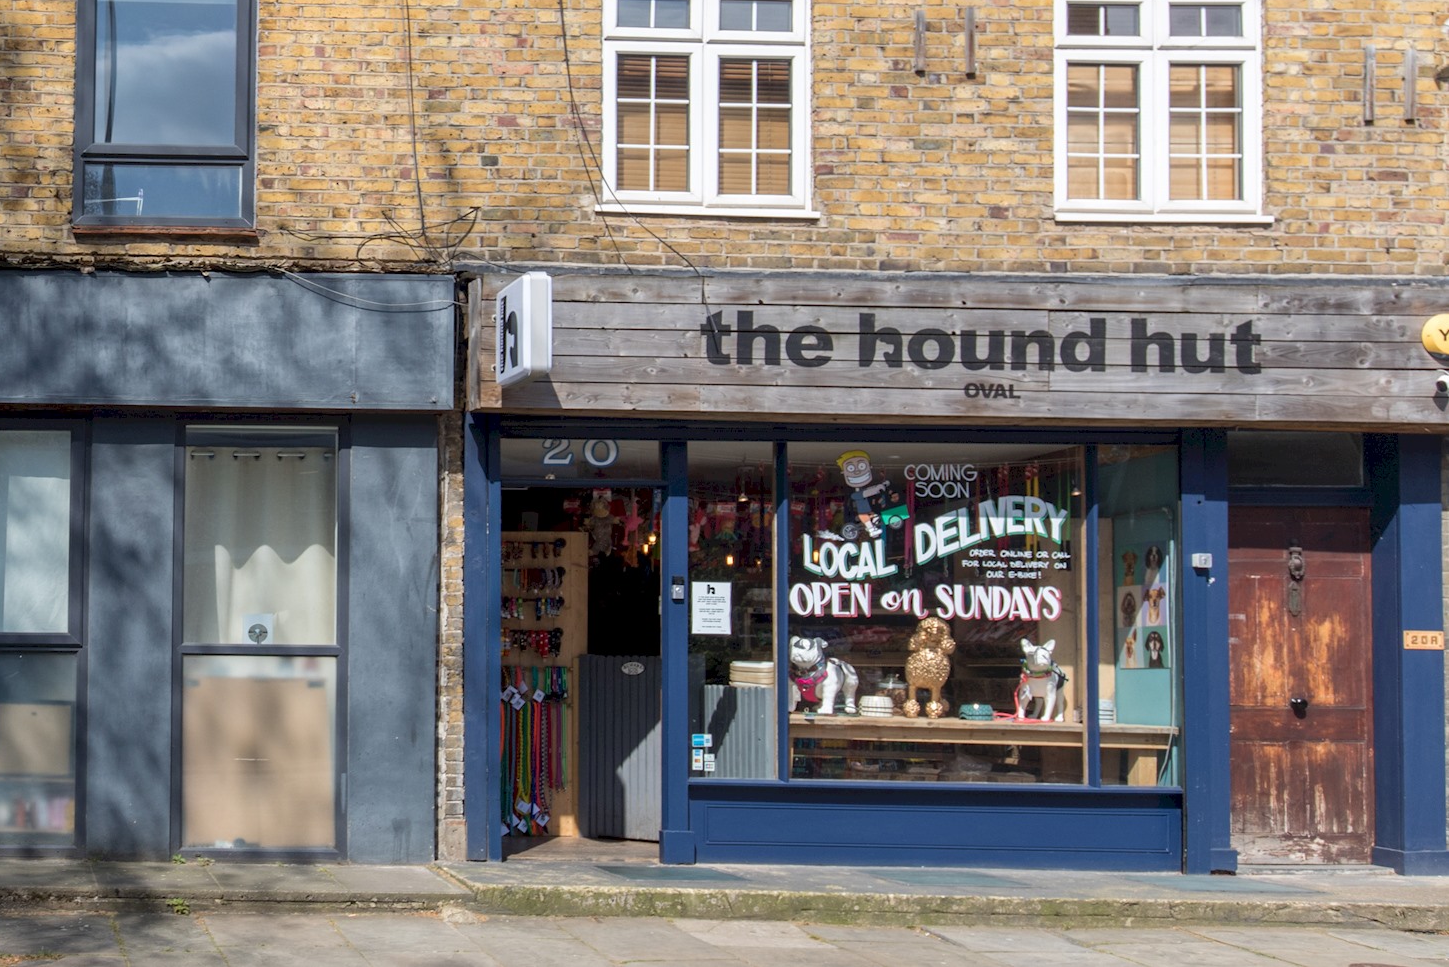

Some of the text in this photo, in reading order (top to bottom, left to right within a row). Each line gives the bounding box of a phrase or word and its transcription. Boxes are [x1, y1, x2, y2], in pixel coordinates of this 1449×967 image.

[700, 310, 1262, 375] the hound hut
[964, 382, 1021, 399] OVAL
[542, 438, 619, 467] 20
[904, 463, 978, 482] COMING
[915, 481, 970, 498] SOON
[803, 494, 1068, 581] LOCAL DELIVERY
[969, 549, 1071, 559] ORDER ONLINE OR CALL
[961, 559, 1067, 570] FOR LOCAL DELIVERY ON
[986, 570, 1005, 579] OUR
[789, 582, 1062, 621] OPEN on SUNDAYS
[1411, 635, 1438, 645] 20A
